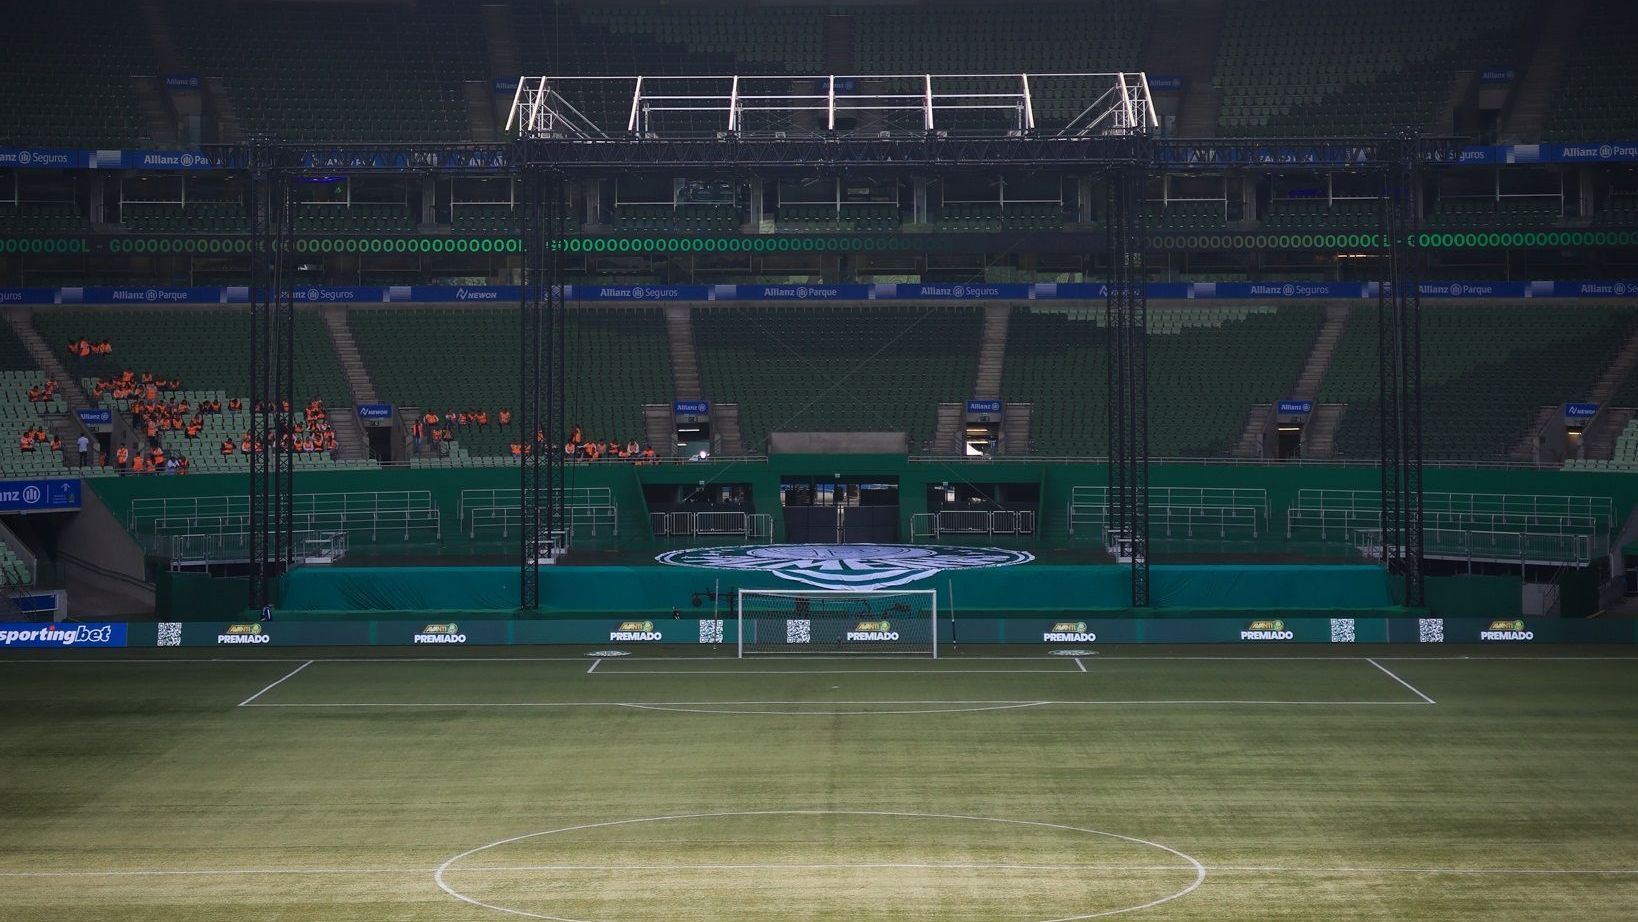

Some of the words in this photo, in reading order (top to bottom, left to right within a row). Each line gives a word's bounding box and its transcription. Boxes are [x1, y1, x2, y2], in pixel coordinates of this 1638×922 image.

[1562, 147, 1598, 157] Allianz
[33, 152, 67, 164] Seguros
[144, 154, 179, 164] Allianz
[600, 288, 631, 297] Allianz
[645, 288, 678, 299] Seguros
[764, 288, 794, 297] Allianz
[808, 288, 837, 299] Parque
[920, 287, 951, 296] Allianz
[966, 286, 999, 298] Seguros
[1250, 285, 1281, 295] Allianz
[1296, 285, 1329, 298] Seguros
[1462, 285, 1492, 297] Parque
[1581, 284, 1612, 294] Allianz
[112, 291, 144, 300] Allianz
[158, 291, 188, 301] Parque
[320, 290, 354, 301] Seguros
[0, 624, 112, 645] sportingbet
[217, 634, 270, 644] PREMIADO
[413, 634, 467, 644] PREMIADO
[610, 631, 662, 641] PREMIADO
[847, 631, 899, 641] PREMIADO
[1043, 632, 1096, 642] PREMIADO
[1240, 630, 1294, 640] PREMIADO
[1480, 631, 1534, 641] PREMIADO
